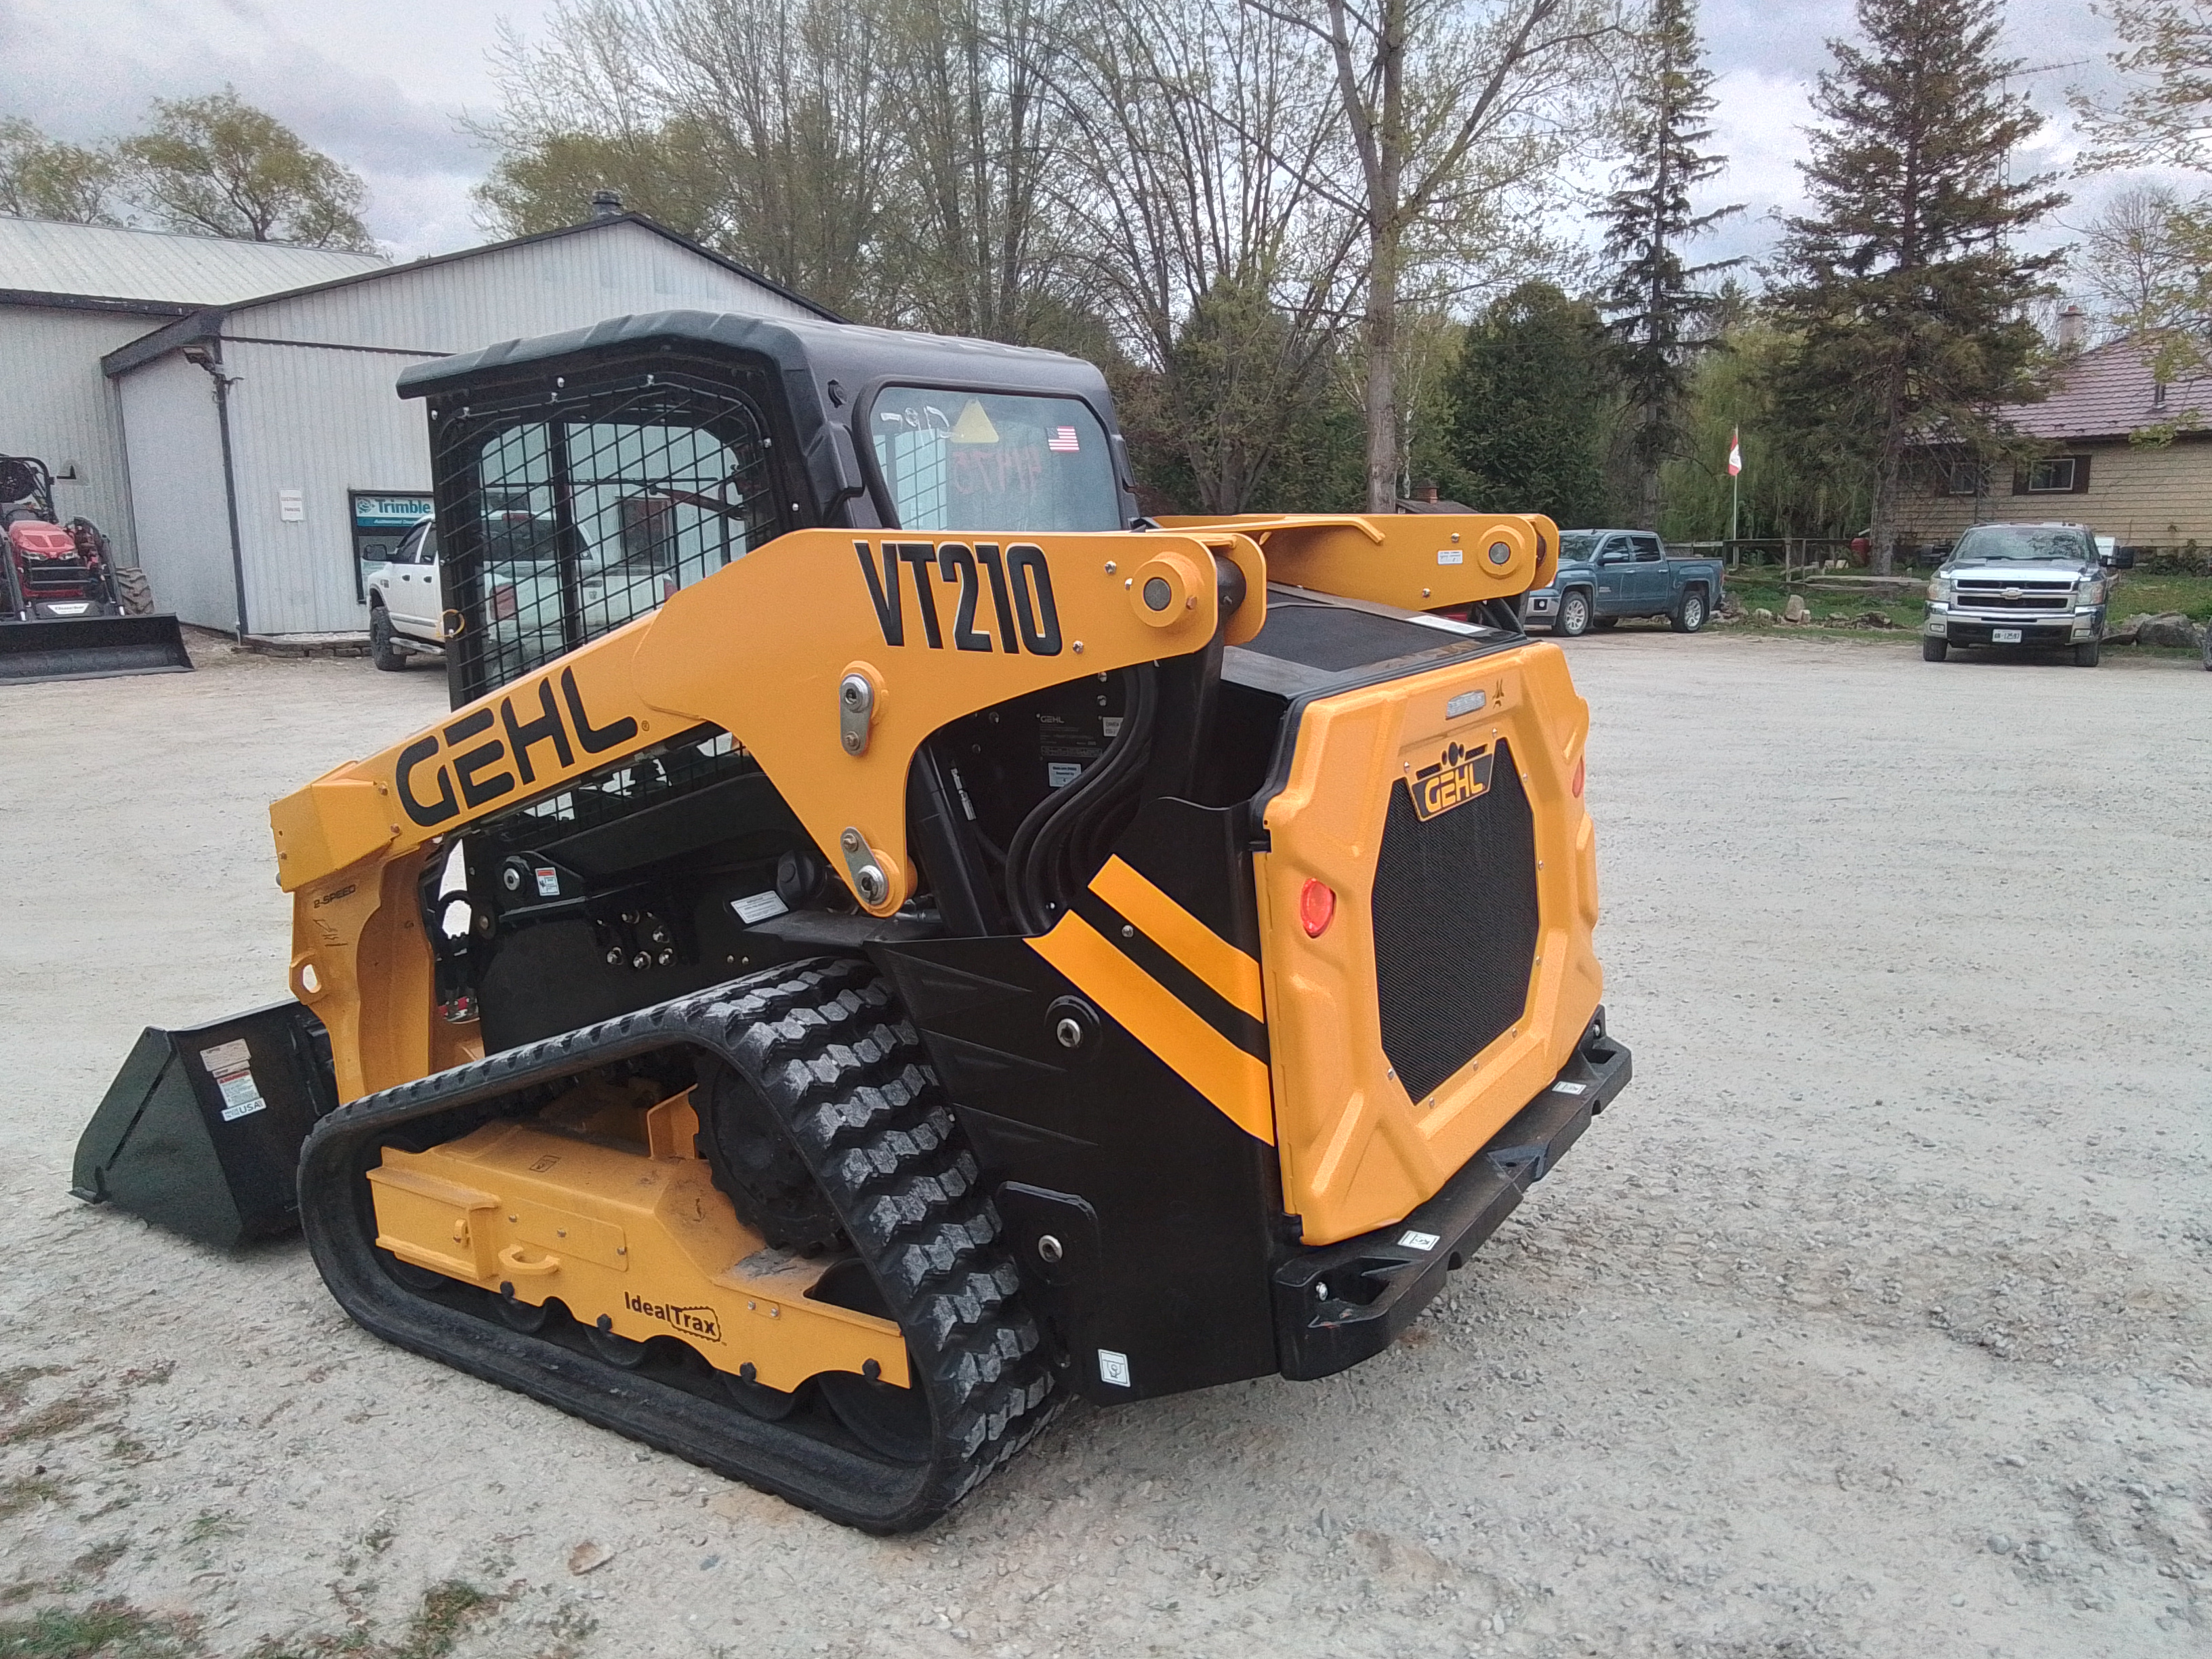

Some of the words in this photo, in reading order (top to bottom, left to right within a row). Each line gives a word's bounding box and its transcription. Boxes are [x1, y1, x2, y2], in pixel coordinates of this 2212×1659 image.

[375, 499, 431, 514] Trimble
[852, 539, 1063, 657] VT210
[1040, 716, 1065, 724] GEHL
[396, 665, 638, 827] GEHL
[1425, 763, 1483, 813] GEHL
[239, 1101, 262, 1113] USA
[624, 1291, 718, 1337] IdealTrax
